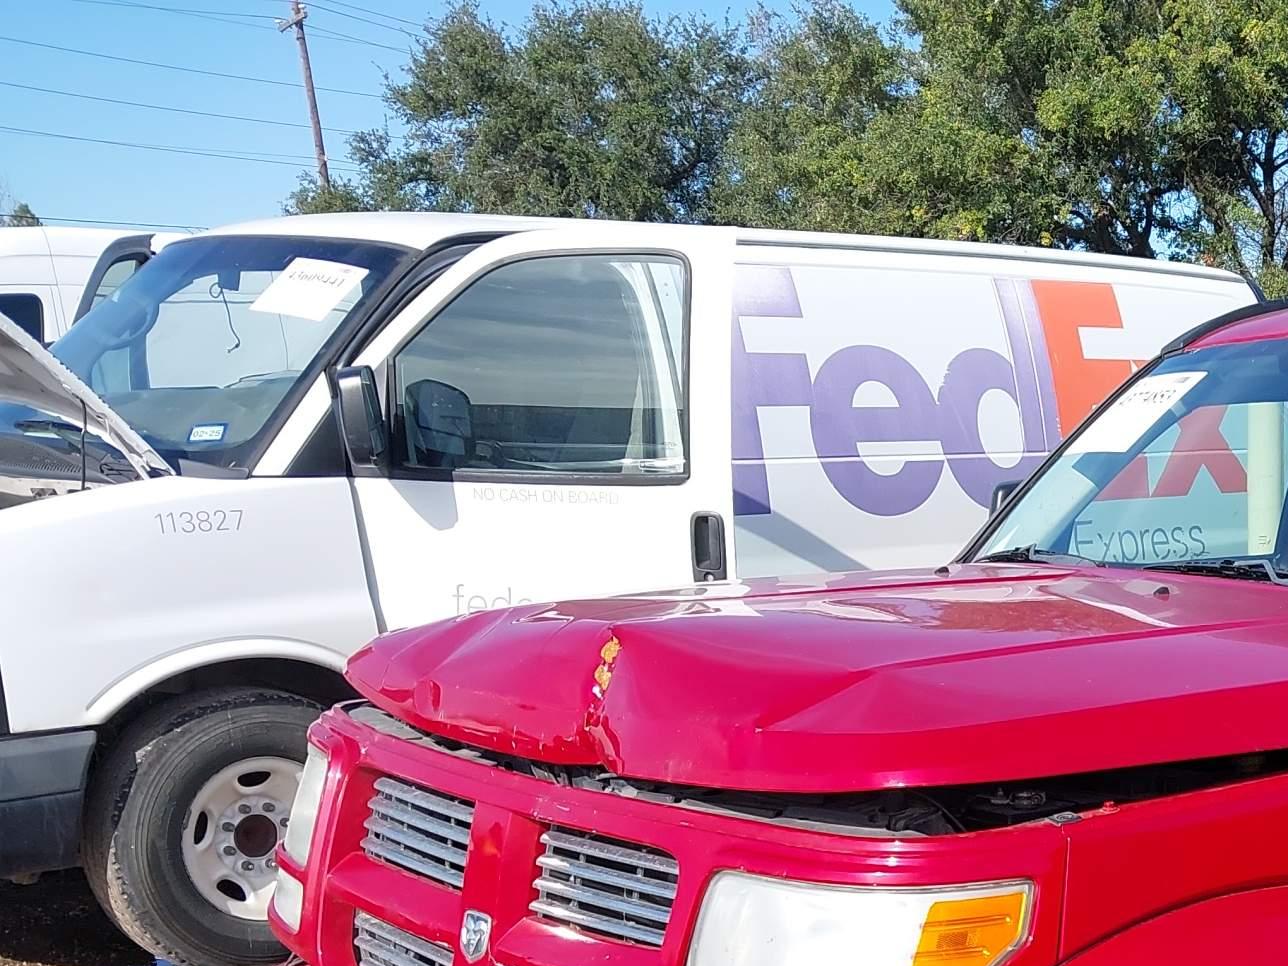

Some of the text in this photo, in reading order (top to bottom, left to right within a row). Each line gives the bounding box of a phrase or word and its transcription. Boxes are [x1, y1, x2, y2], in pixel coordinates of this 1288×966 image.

[731, 265, 1249, 517] FedEx
[473, 488, 619, 505] NO CASH ON BOARD
[154, 510, 243, 534] 113827
[1073, 519, 1207, 562] Express
